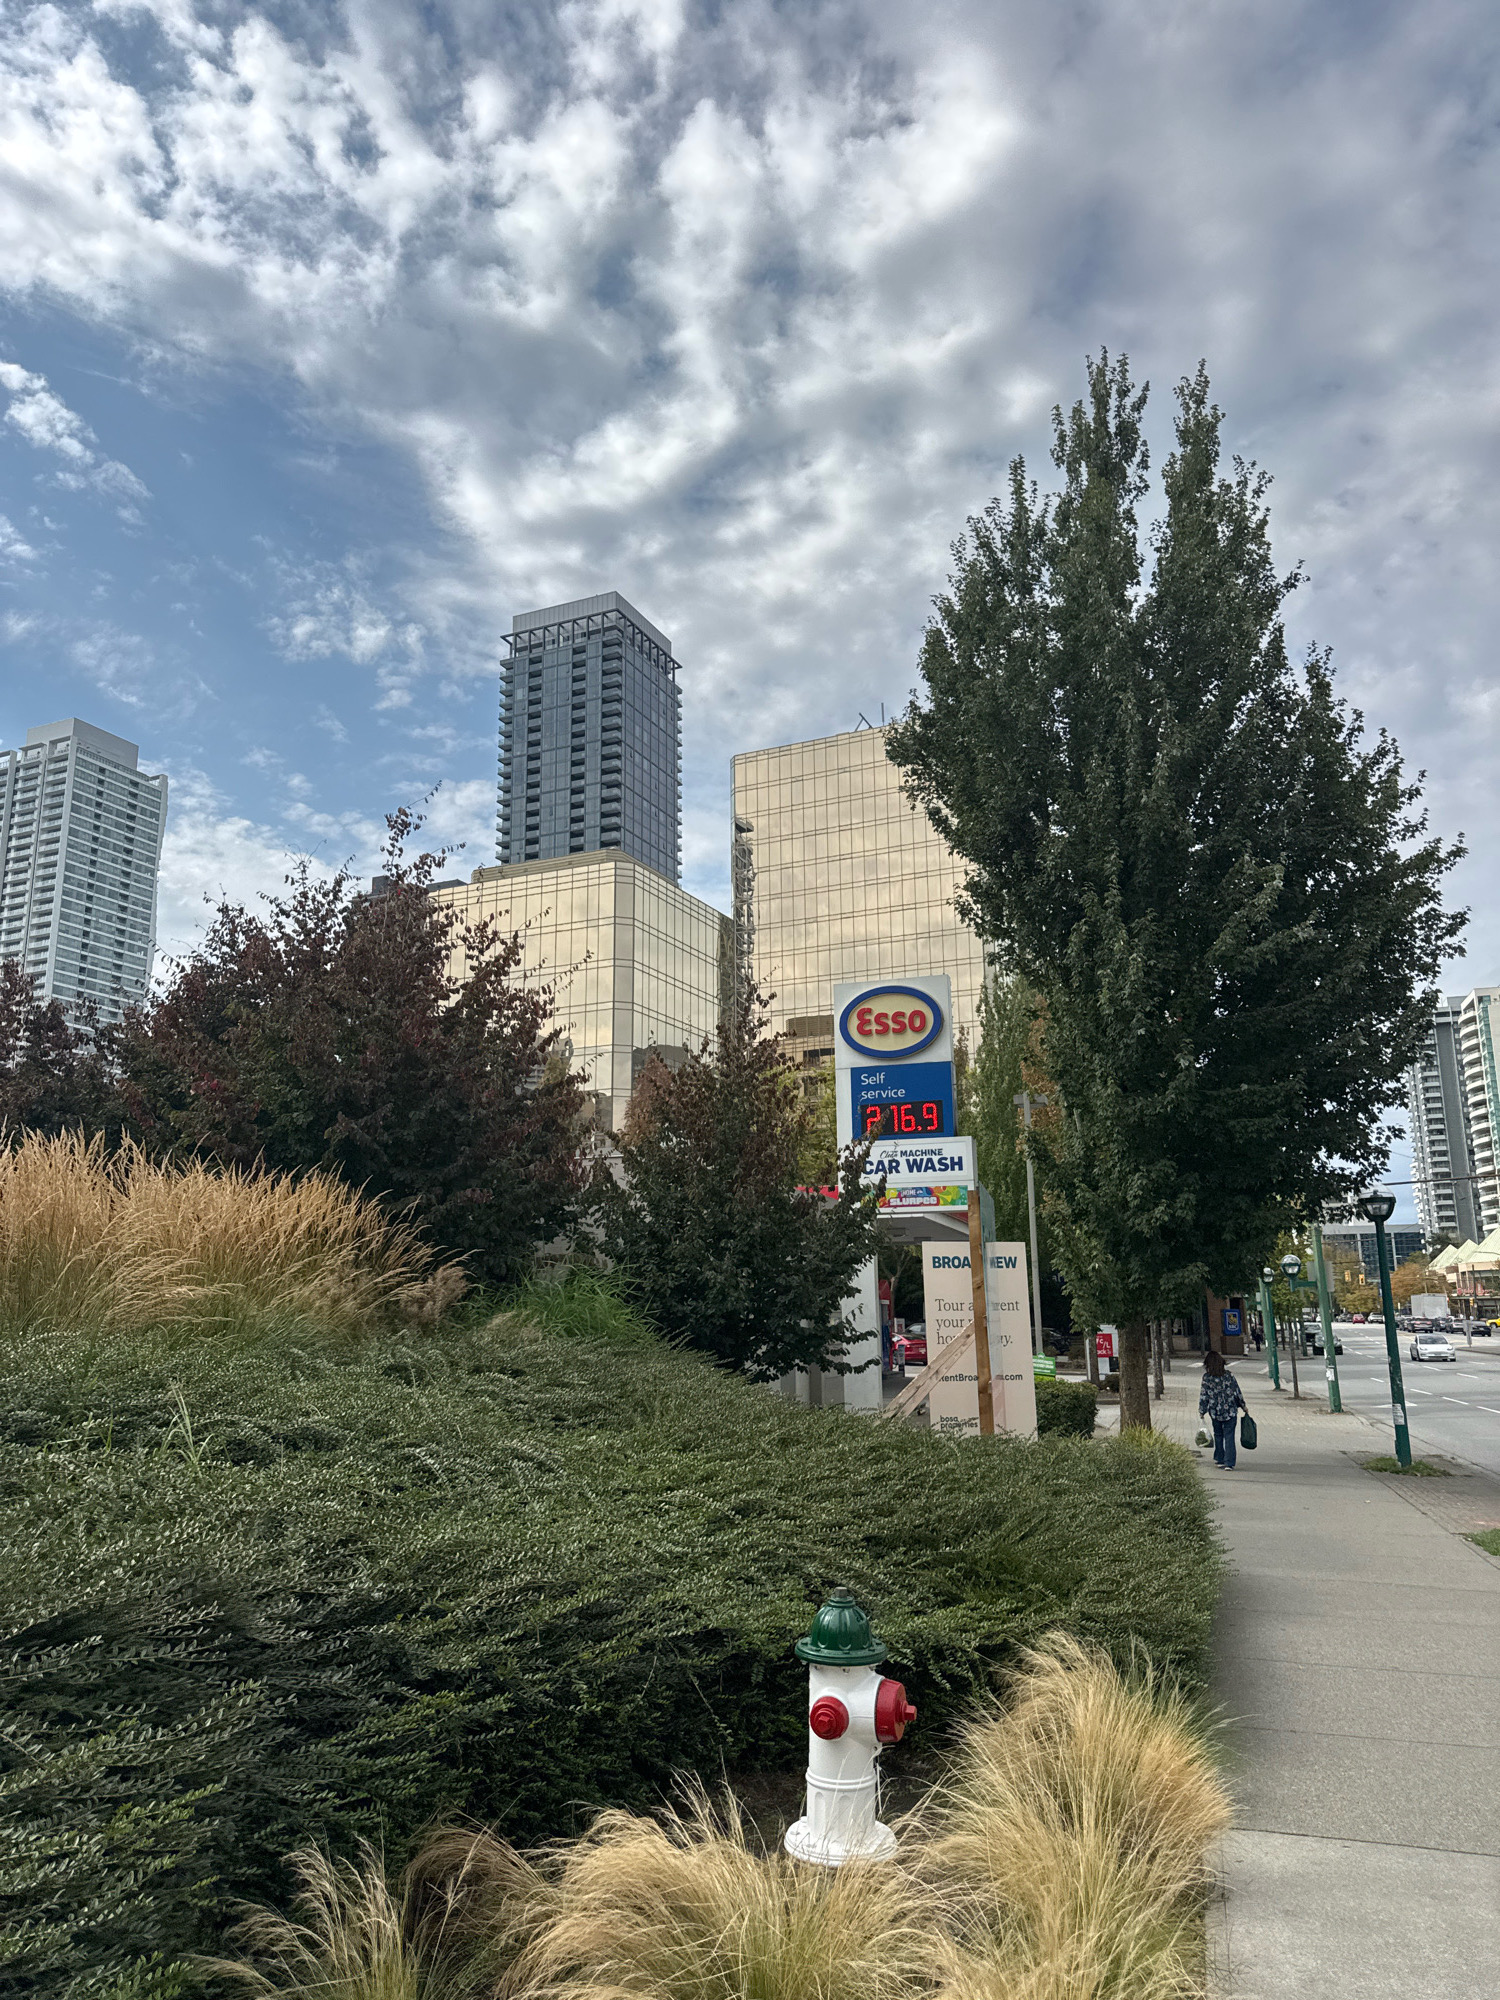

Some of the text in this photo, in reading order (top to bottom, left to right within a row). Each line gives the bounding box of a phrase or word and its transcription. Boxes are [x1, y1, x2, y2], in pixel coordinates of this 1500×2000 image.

[857, 1007, 926, 1035] Esso
[861, 1072, 885, 1085] Self
[861, 1086, 905, 1100] service
[866, 1103, 938, 1134] 216.9
[900, 1148, 943, 1158] MACHINE
[863, 1156, 963, 1175] CAR WASH
[935, 1299, 964, 1312] Tour
[936, 1319, 964, 1331] your
